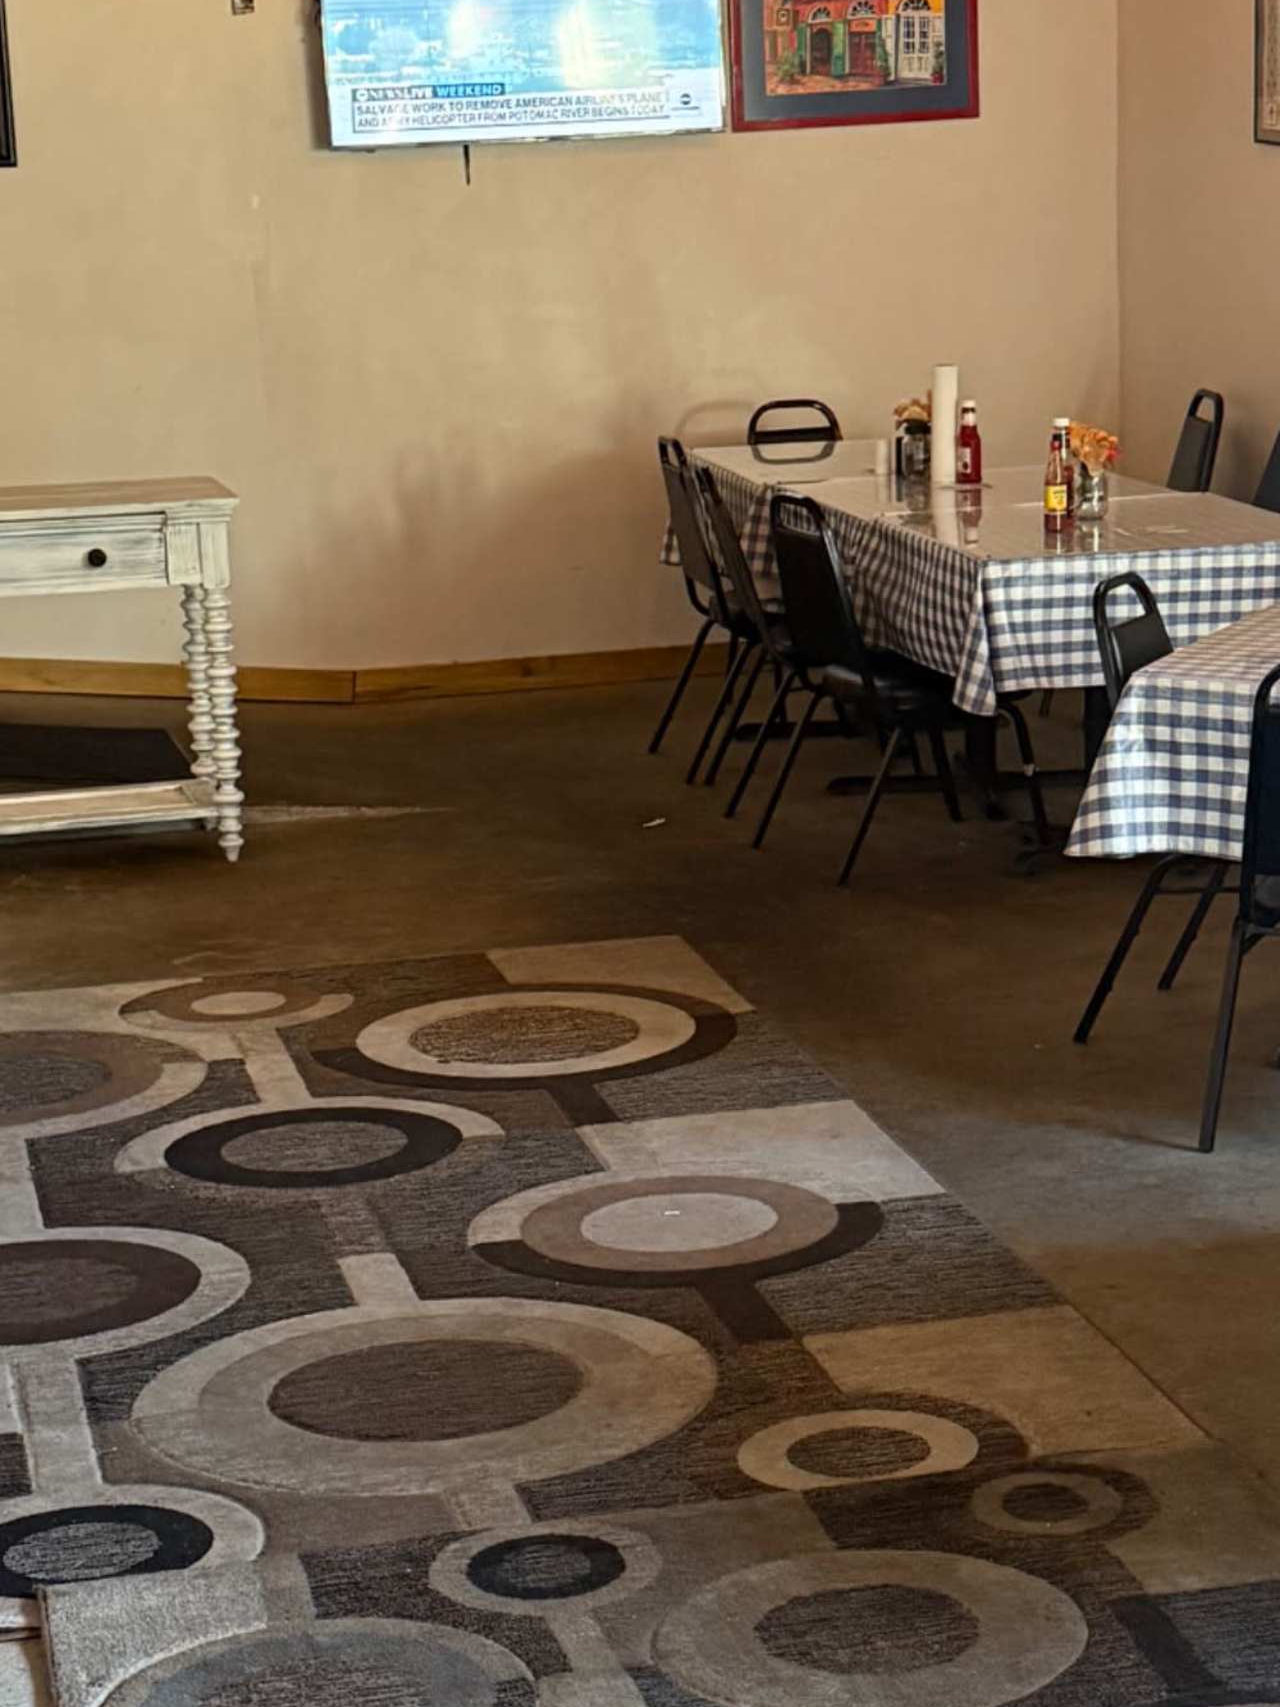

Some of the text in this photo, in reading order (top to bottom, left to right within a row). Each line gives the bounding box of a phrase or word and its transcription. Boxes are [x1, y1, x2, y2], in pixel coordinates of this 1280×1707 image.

[437, 85, 502, 97] WEEKEND
[412, 101, 446, 113] WORK
[448, 100, 464, 112] TO
[466, 98, 513, 111] REMOVE
[515, 95, 573, 108] AMERICAN
[357, 116, 380, 127] AND
[382, 115, 410, 127] AY
[412, 112, 477, 125] HELICOPTER
[478, 111, 506, 123] FROM
[508, 108, 558, 121] POTOMAC
[560, 107, 590, 119] RIVER
